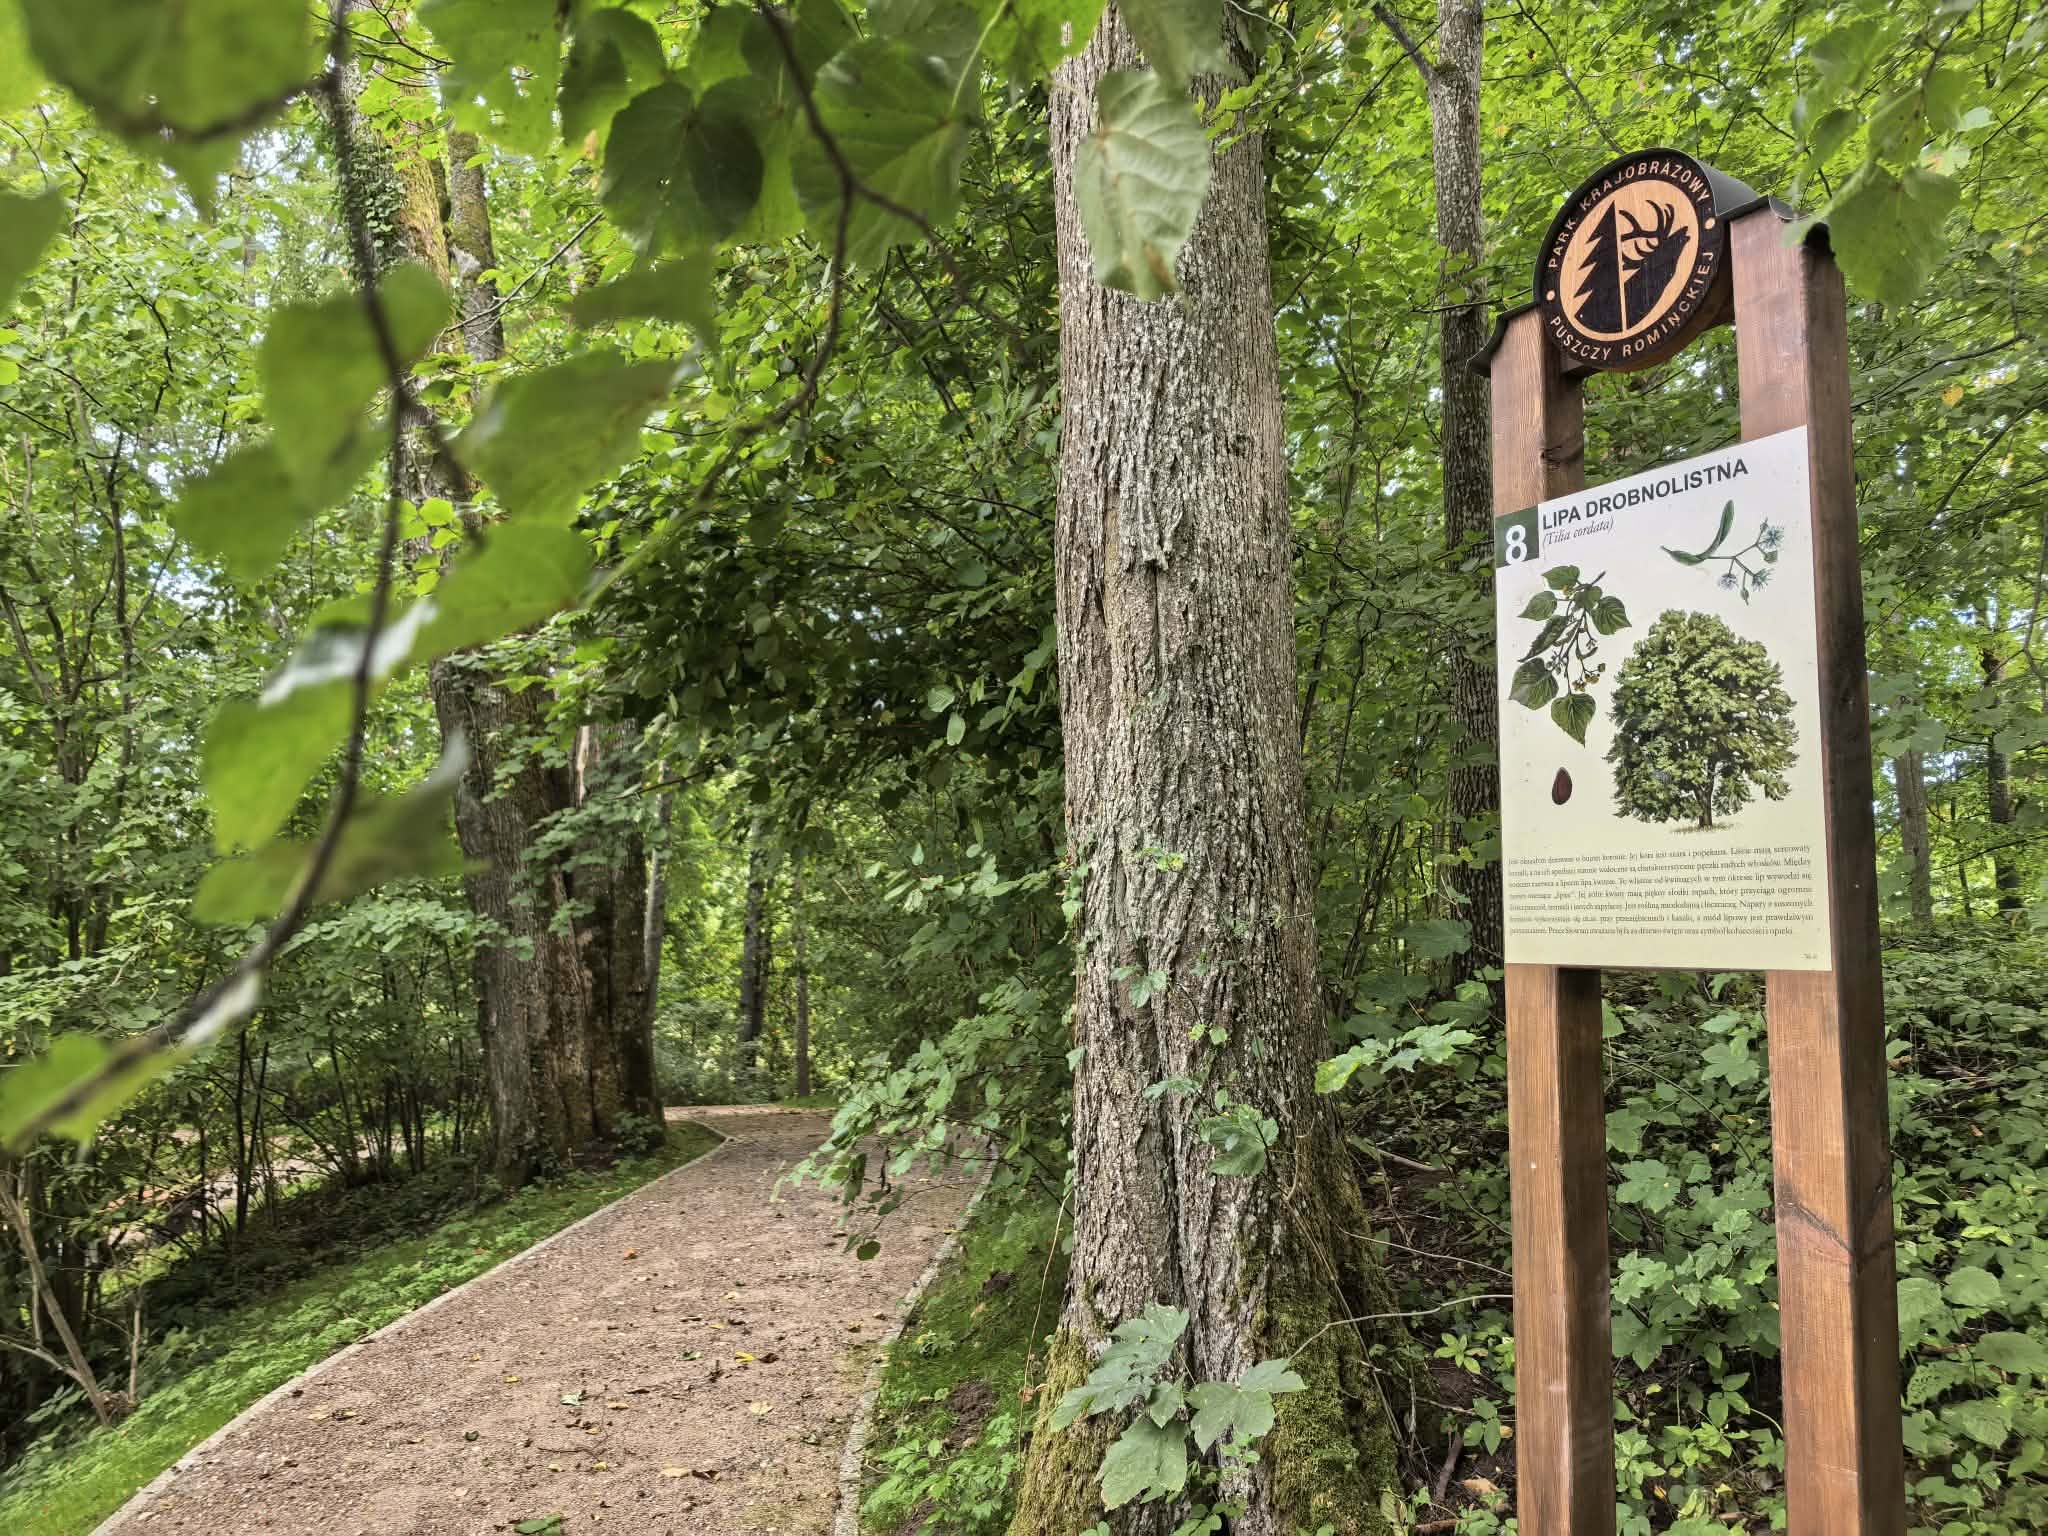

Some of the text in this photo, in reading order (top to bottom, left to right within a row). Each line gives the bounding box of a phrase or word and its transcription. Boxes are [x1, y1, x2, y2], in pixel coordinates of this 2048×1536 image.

[1548, 160, 1711, 268] PARK KRAJOBRAZOWY
[1550, 250, 1714, 361] PUSZCZY ROMINCKIEJ
[1542, 458, 1749, 530] LIPA DROBNOLISTNA
[1505, 524, 1528, 566] 8
[1542, 516, 1615, 546] (Tilia cordata)
